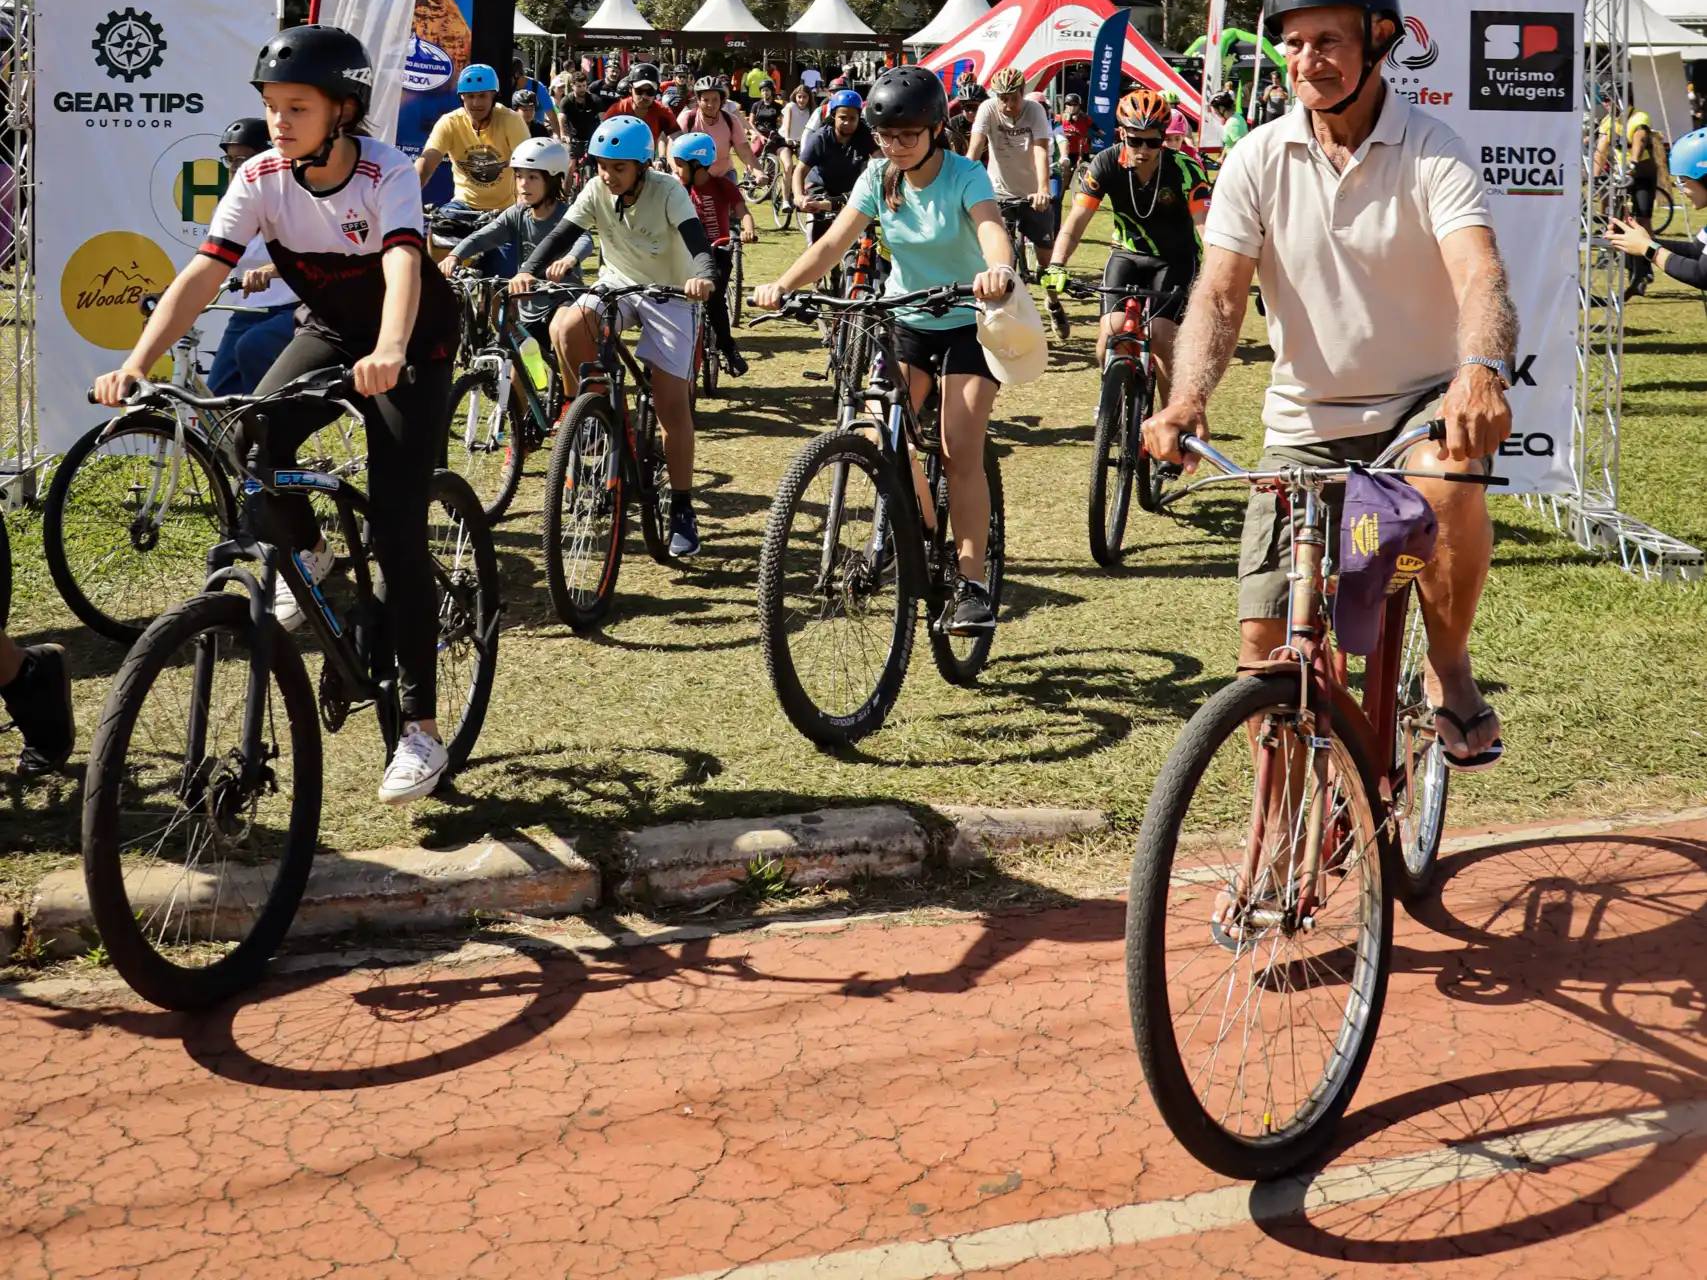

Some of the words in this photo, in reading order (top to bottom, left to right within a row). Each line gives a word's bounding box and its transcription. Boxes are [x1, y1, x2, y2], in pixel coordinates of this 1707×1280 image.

[727, 40, 748, 48] SOL
[413, 61, 446, 71] AVENTURA
[1099, 44, 1114, 91] deuter
[1486, 68, 1555, 82] Turismo
[1480, 86, 1491, 97] e
[1496, 83, 1566, 101] Viagens
[53, 92, 134, 113] GEAR
[139, 93, 204, 114] TIPS
[86, 119, 172, 128] OUTDOOR
[1481, 146, 1556, 166] BENTO
[1483, 162, 1565, 187] APUCAÍ
[342, 220, 368, 232] SPFC
[702, 194, 721, 238] ADVENTUR
[1511, 354, 1538, 387] K
[1499, 432, 1556, 457] EQ
